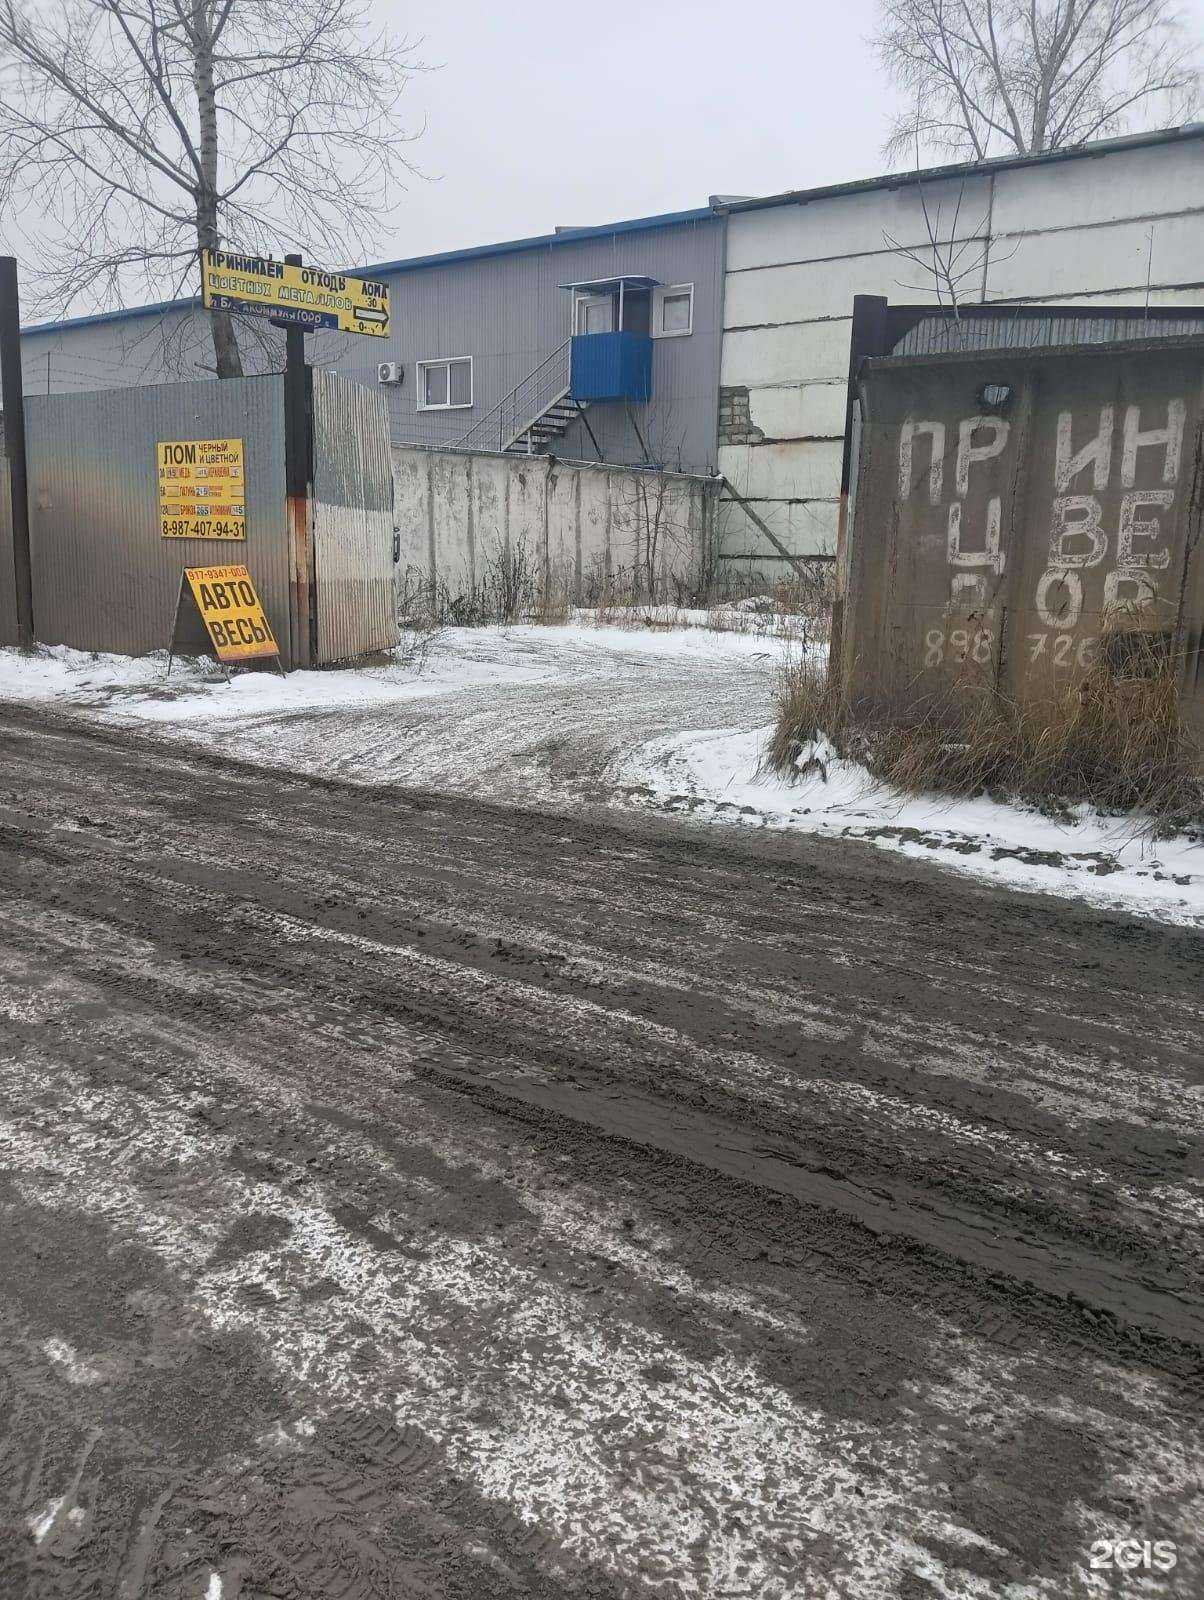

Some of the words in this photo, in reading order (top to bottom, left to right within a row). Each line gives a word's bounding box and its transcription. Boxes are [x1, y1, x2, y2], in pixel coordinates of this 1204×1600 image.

[277, 285, 353, 311] МЕТАЛЛОВ
[164, 444, 196, 465] ЛОМ
[198, 441, 228, 453] ЧЕРНЫЙ
[162, 520, 245, 537] 8-987-407-94-31
[199, 580, 256, 610] АВТО
[208, 616, 273, 647] ВЕСЫ
